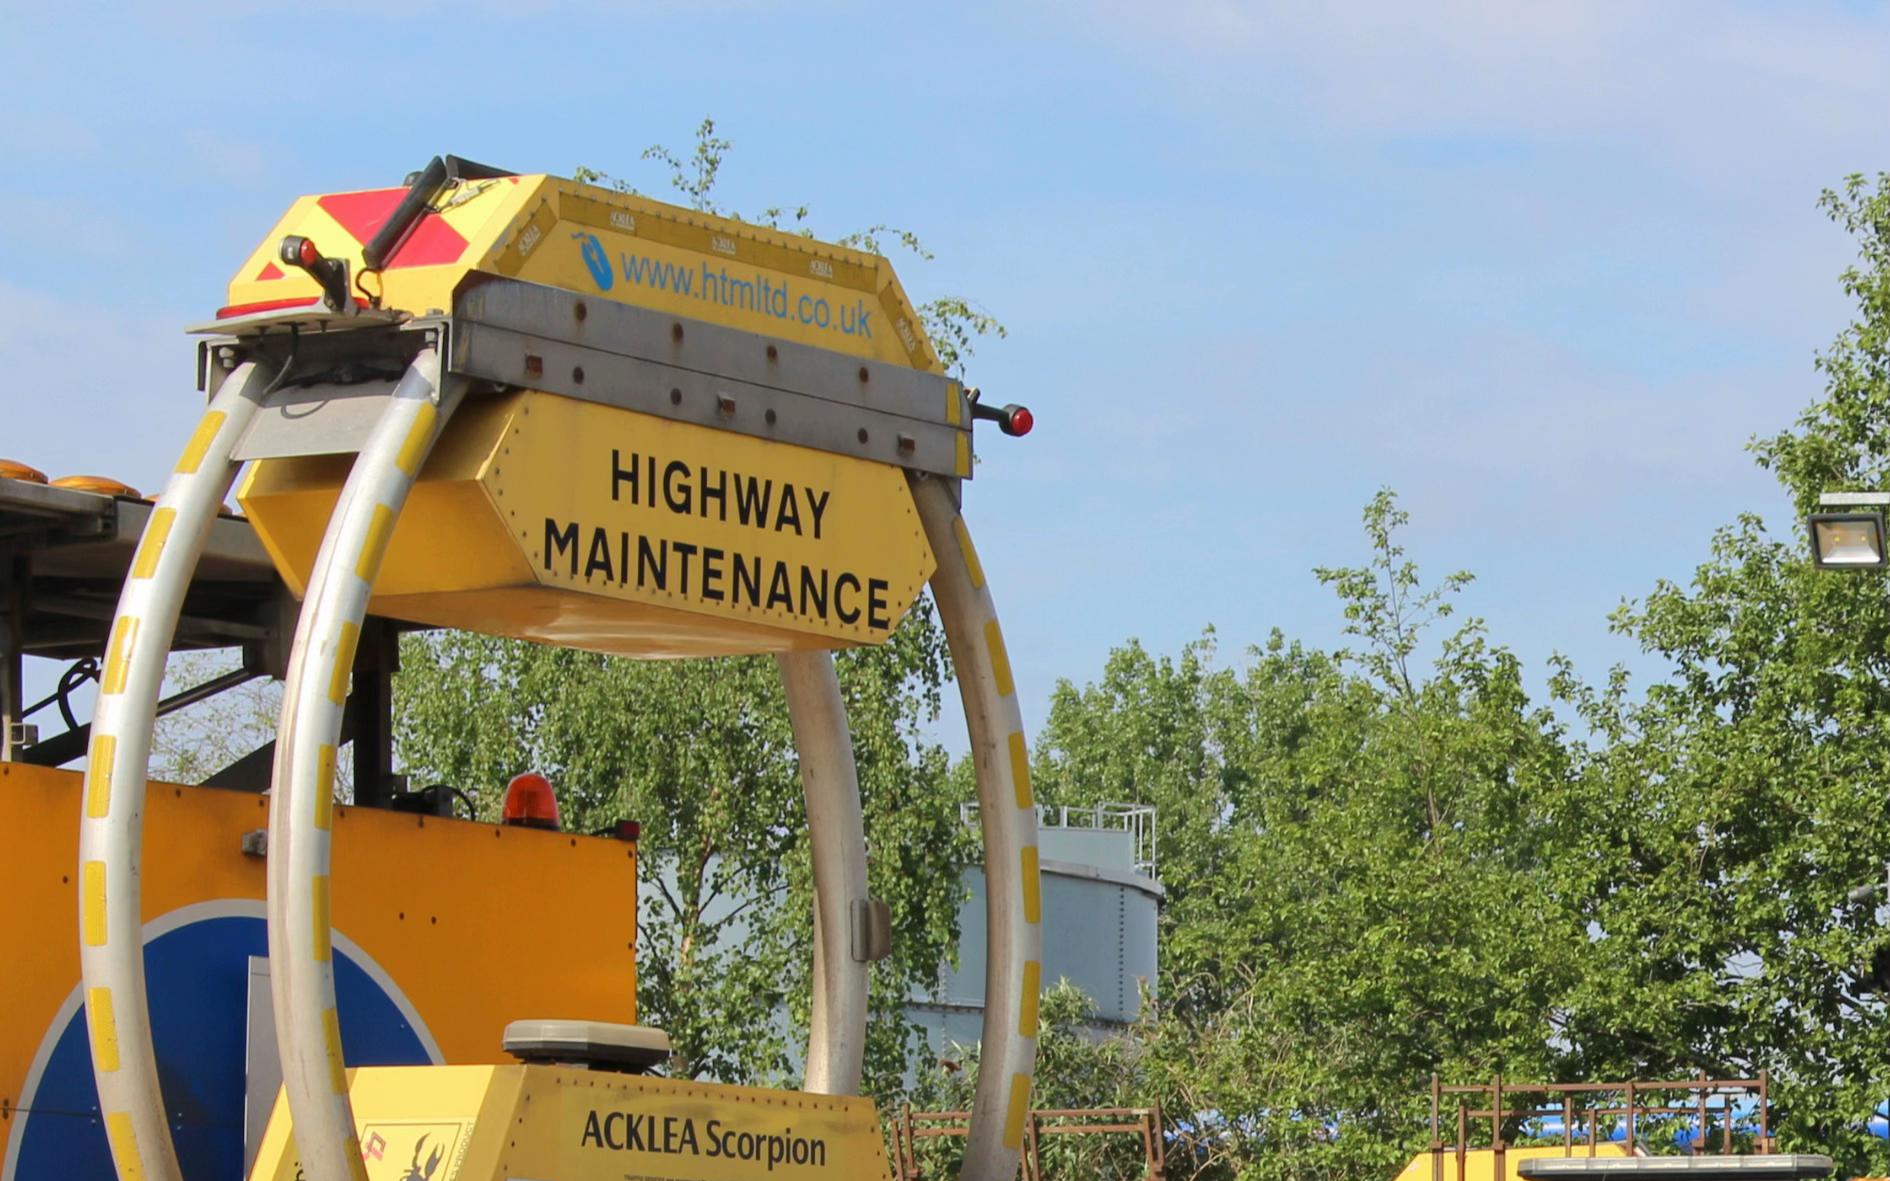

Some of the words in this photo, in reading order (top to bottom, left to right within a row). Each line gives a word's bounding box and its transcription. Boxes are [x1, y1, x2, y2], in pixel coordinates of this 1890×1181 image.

[621, 252, 872, 338] www.htmltd.co.uk
[612, 449, 830, 540] HIGHWAY
[544, 518, 890, 630] MAINTENANCE
[581, 1110, 699, 1155] ACKLEA
[706, 1120, 826, 1171] Scorpion
